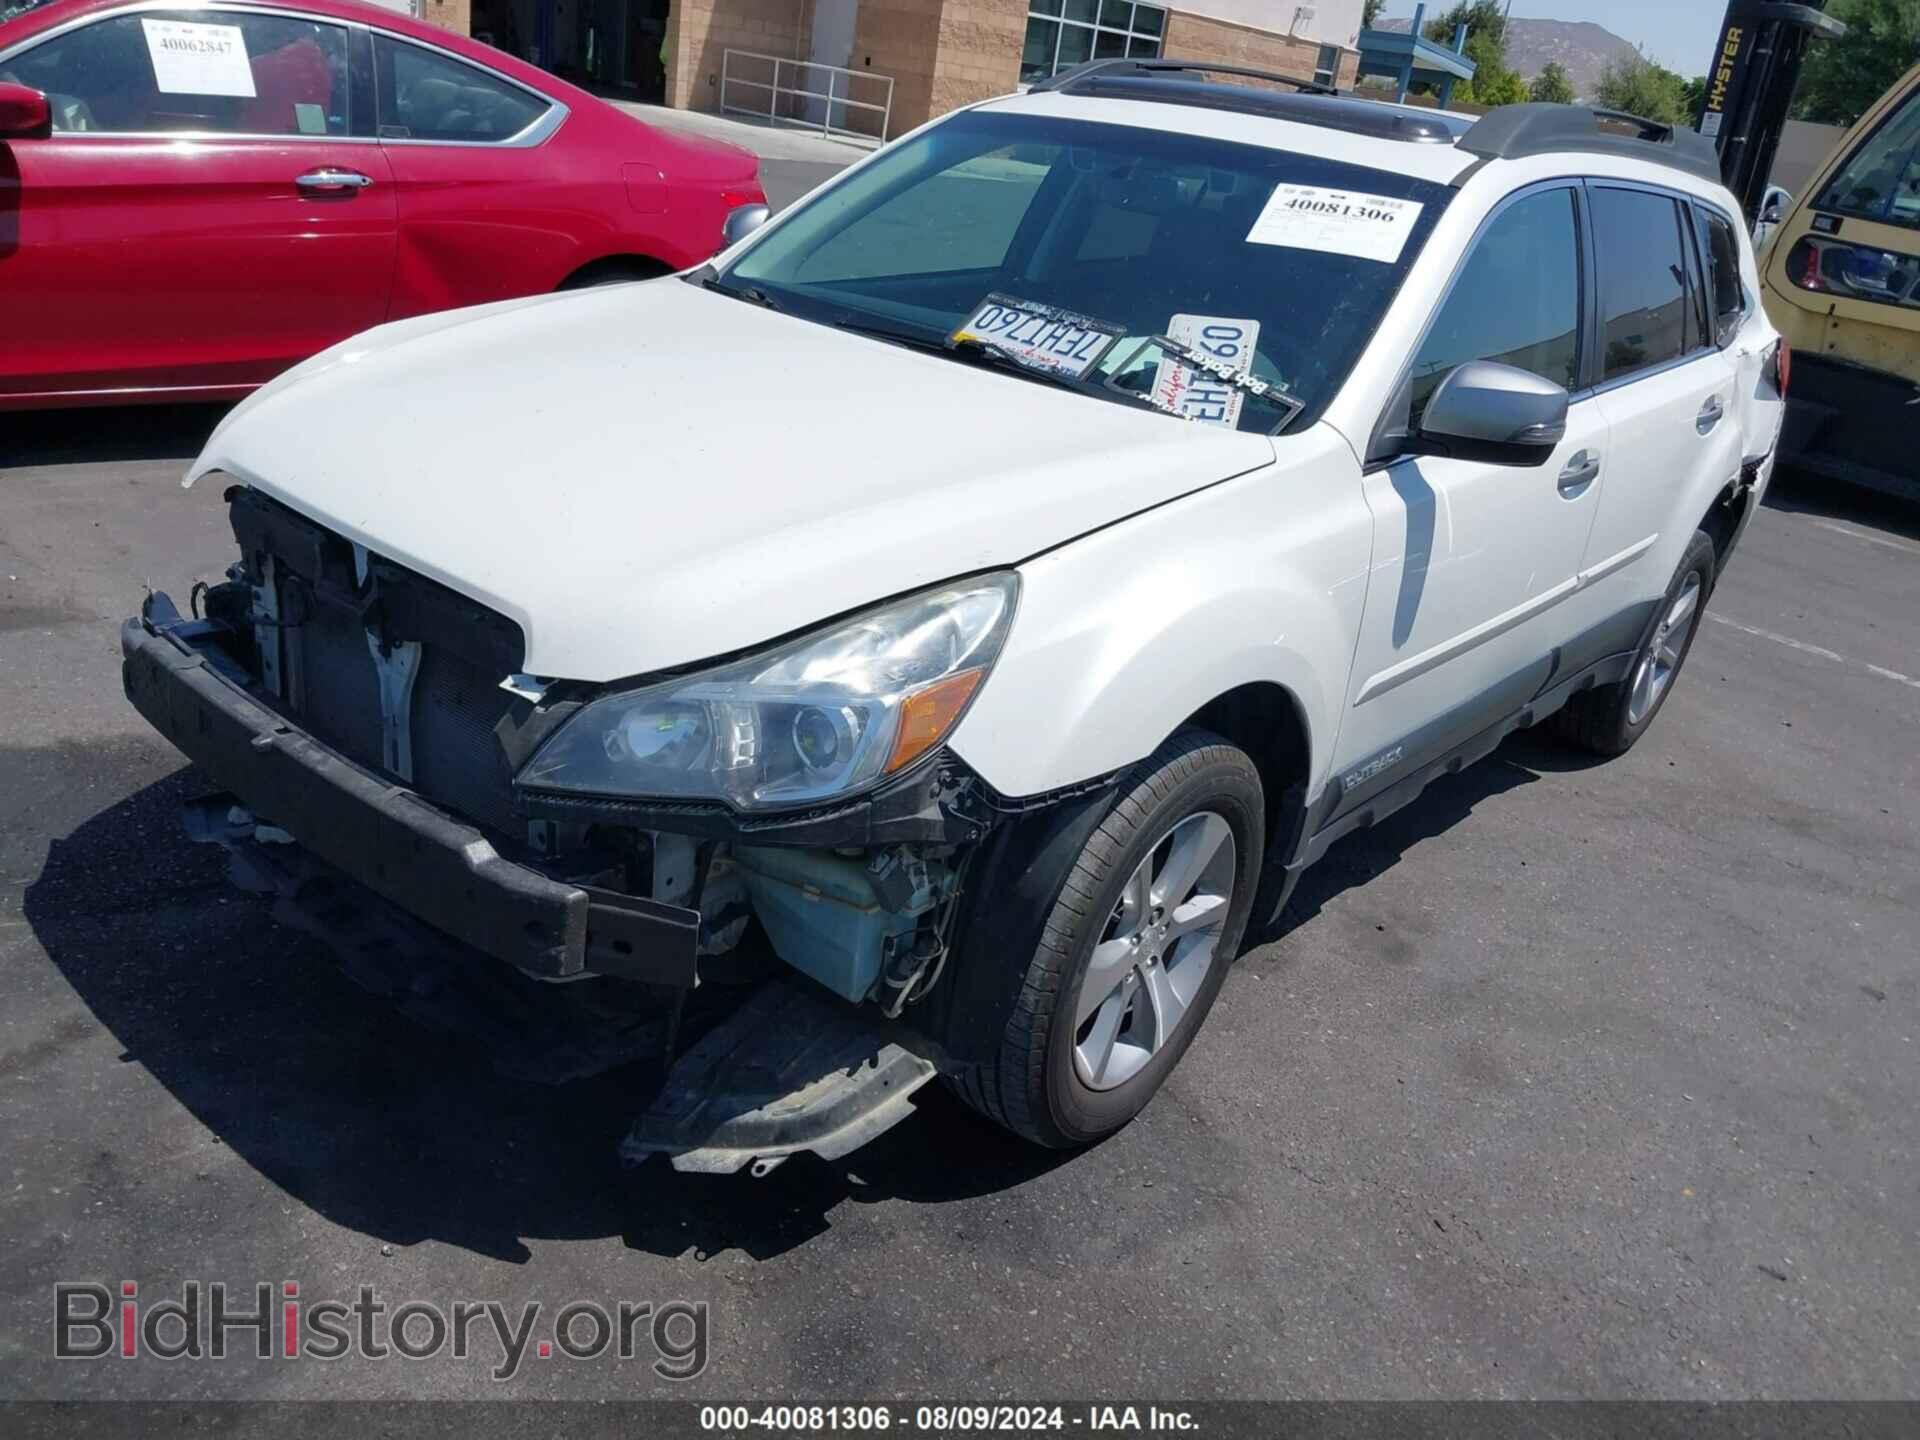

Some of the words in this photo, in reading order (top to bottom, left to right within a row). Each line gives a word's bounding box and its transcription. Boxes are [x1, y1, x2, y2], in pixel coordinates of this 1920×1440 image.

[160, 38, 232, 54] 40062847
[1708, 26, 1743, 111] HYSTER
[1284, 197, 1395, 223] 40081306
[1184, 350, 1240, 380] Baker
[1235, 374, 1269, 395] Bob
